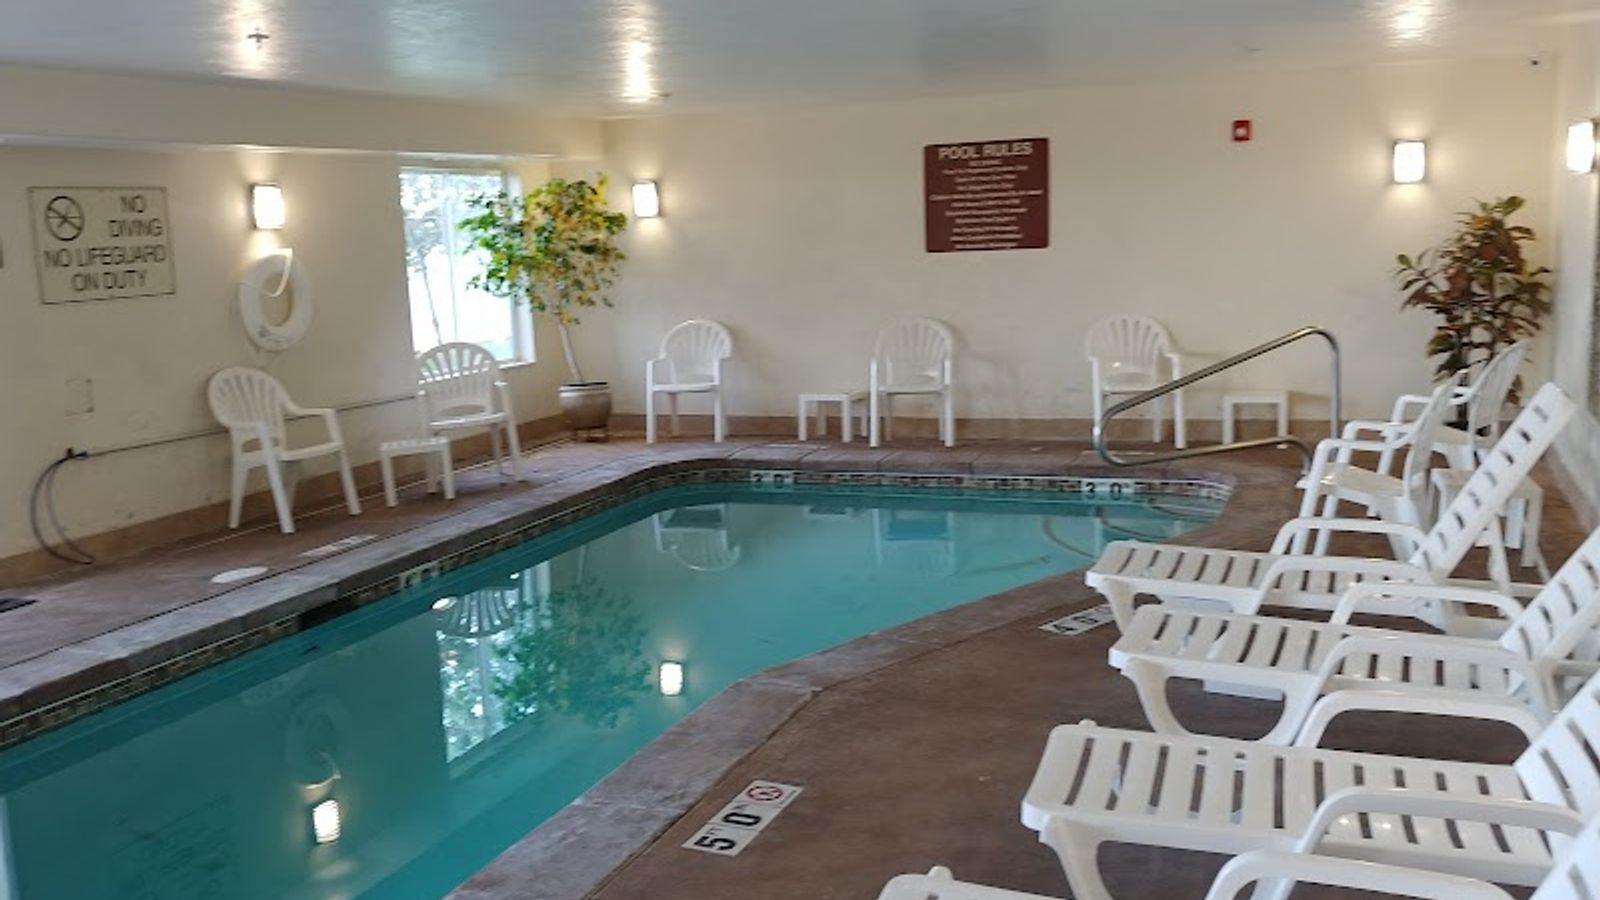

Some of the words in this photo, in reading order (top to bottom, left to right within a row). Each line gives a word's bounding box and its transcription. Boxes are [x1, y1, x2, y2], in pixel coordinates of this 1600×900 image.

[939, 146, 981, 160] POOL
[983, 142, 1033, 156] RULES
[121, 194, 146, 213] NO
[109, 218, 162, 237] DIVING
[43, 248, 73, 268] NO
[76, 245, 166, 267] LIFEGUARD
[71, 272, 99, 292] ON
[102, 269, 147, 290] DUTY
[694, 836, 735, 850] 5
[723, 812, 761, 826] 0
